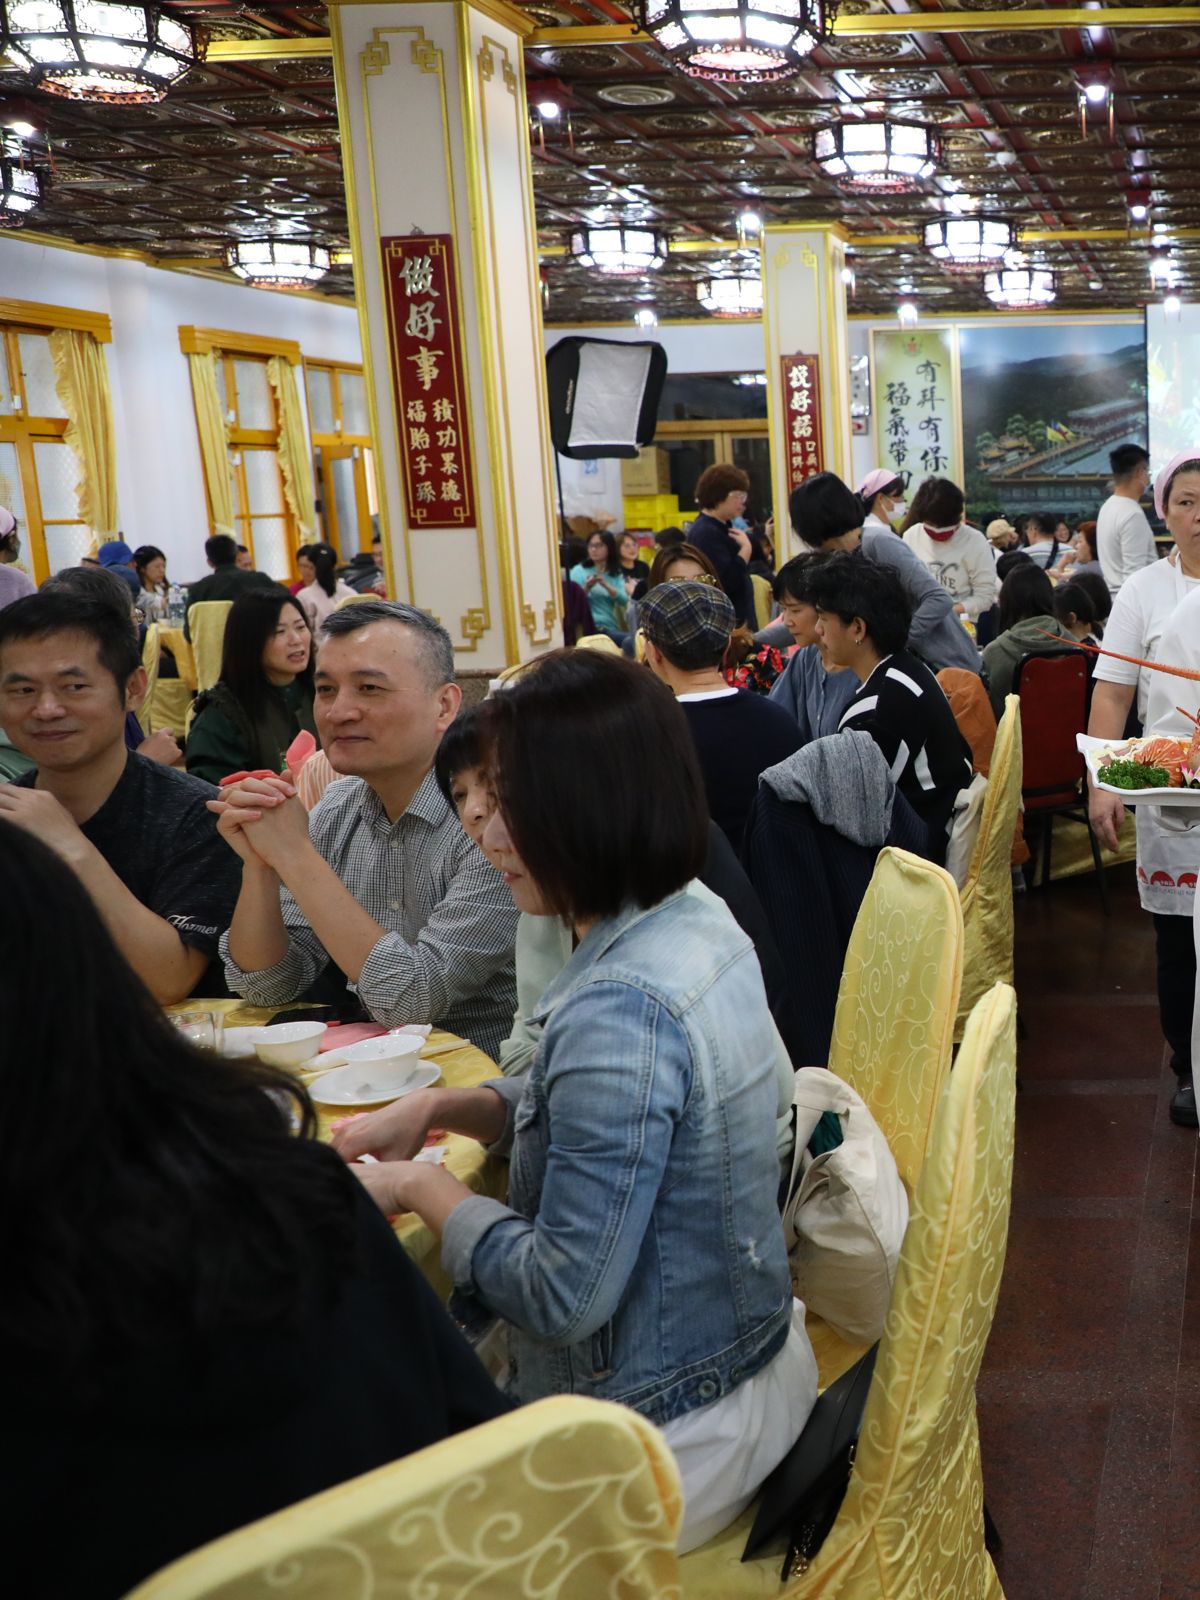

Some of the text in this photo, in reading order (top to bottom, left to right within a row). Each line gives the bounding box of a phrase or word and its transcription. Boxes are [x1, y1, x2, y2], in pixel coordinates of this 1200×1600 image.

[399, 254, 445, 391] 做好事
[788, 364, 813, 439] 說好話
